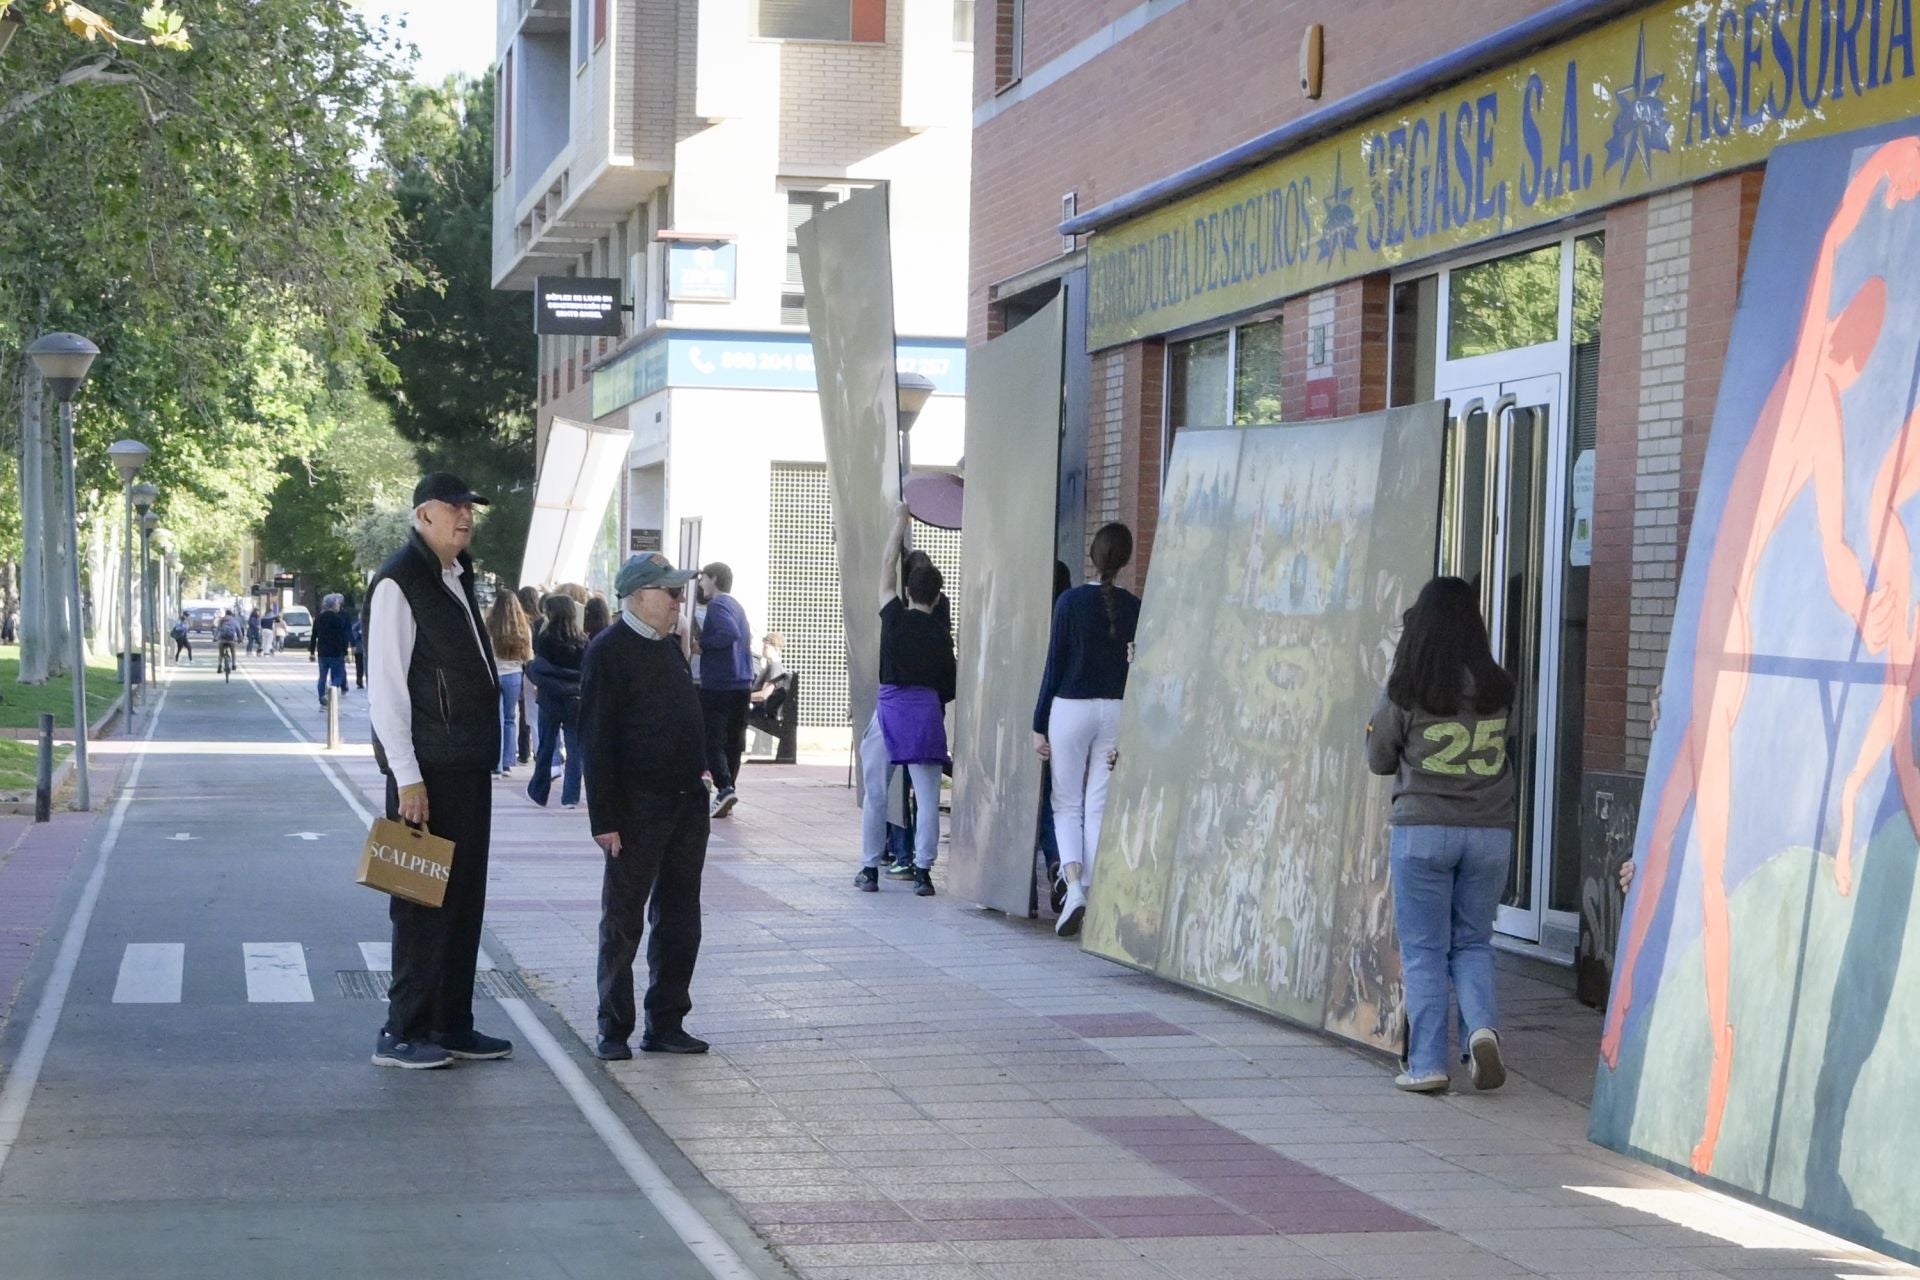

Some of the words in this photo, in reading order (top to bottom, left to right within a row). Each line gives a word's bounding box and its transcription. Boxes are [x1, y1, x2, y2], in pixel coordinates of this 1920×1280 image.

[1685, 0, 1915, 145] ASESORIA
[1519, 59, 1592, 206] S.A.
[1194, 211, 1219, 295] DE
[1220, 176, 1312, 288] SEGUROS
[1422, 719, 1507, 775] 25
[370, 841, 452, 882] SCALPERS
